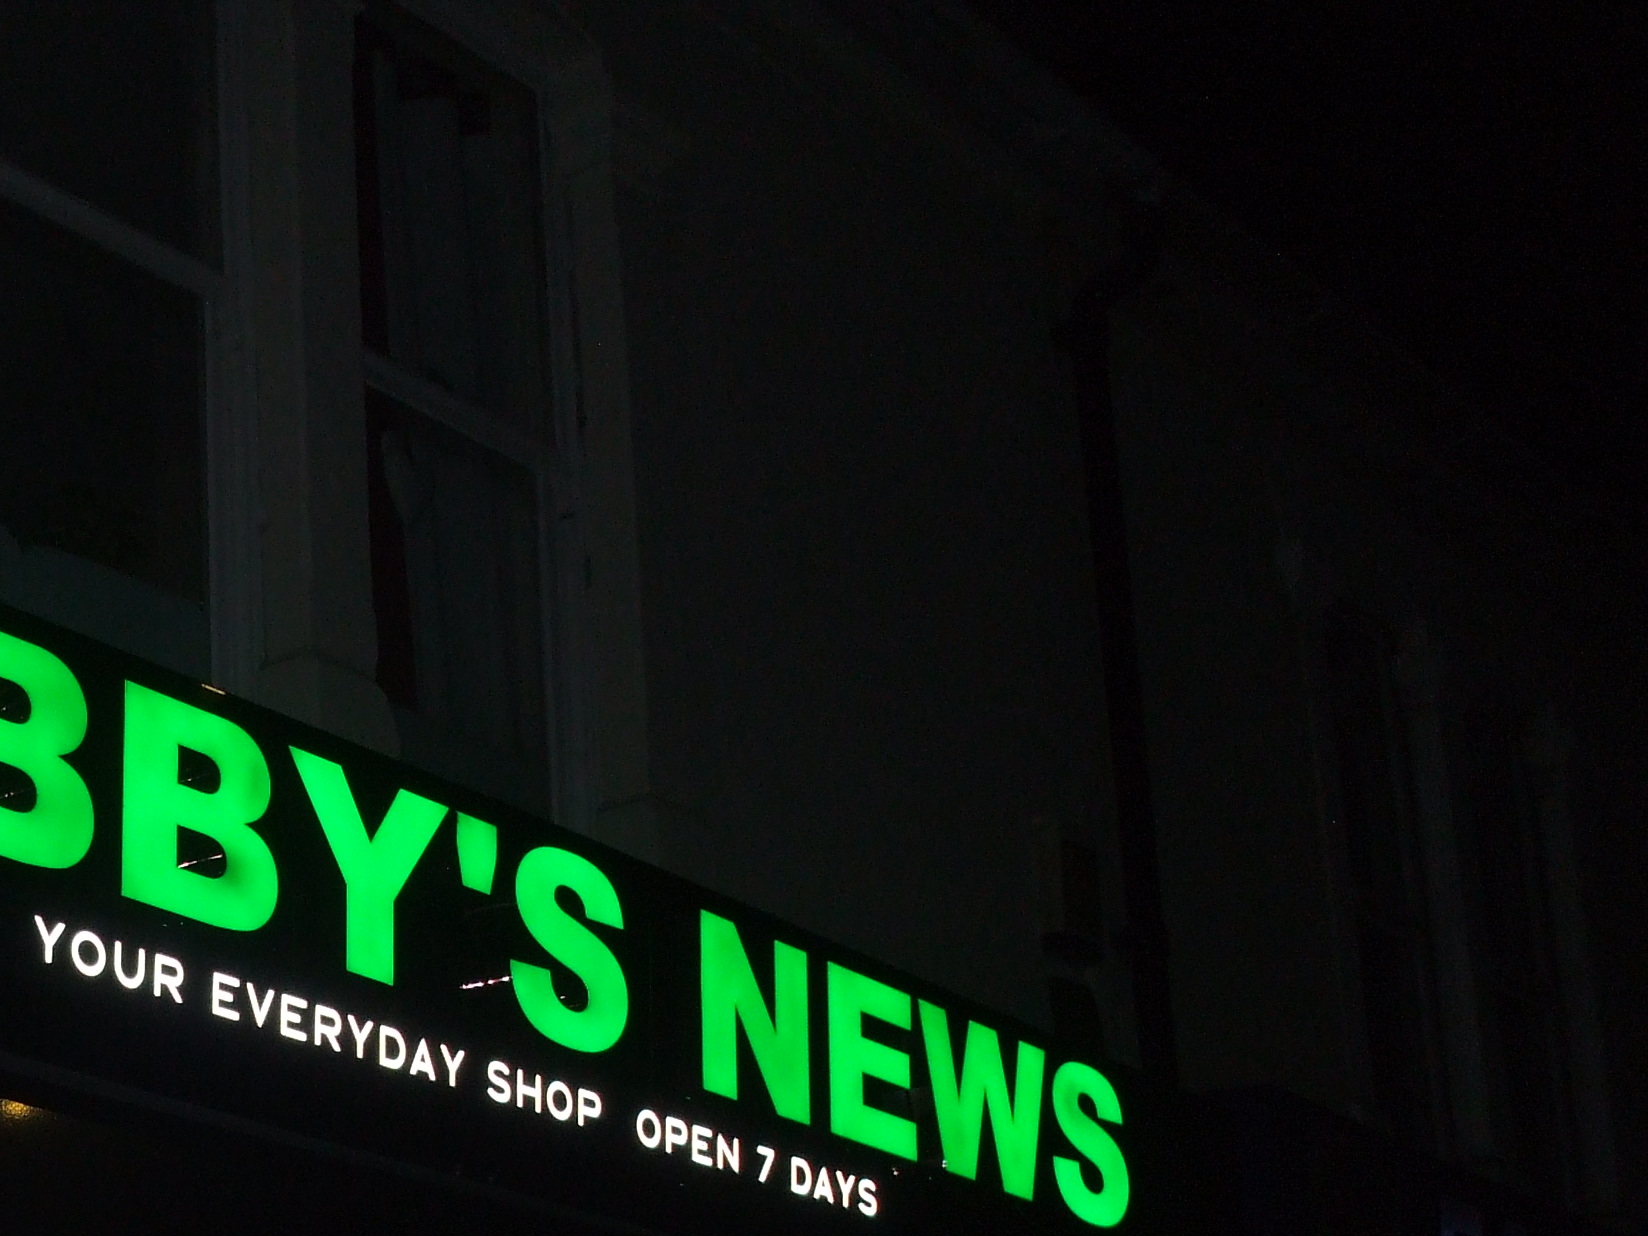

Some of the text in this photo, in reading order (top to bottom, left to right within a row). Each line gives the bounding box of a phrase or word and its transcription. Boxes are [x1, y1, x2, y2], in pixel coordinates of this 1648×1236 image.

[32, 913, 879, 1218] YOUR EVERYDAY SHOP OPEN 7 DAYS
[699, 909, 1130, 1228] NEWS
